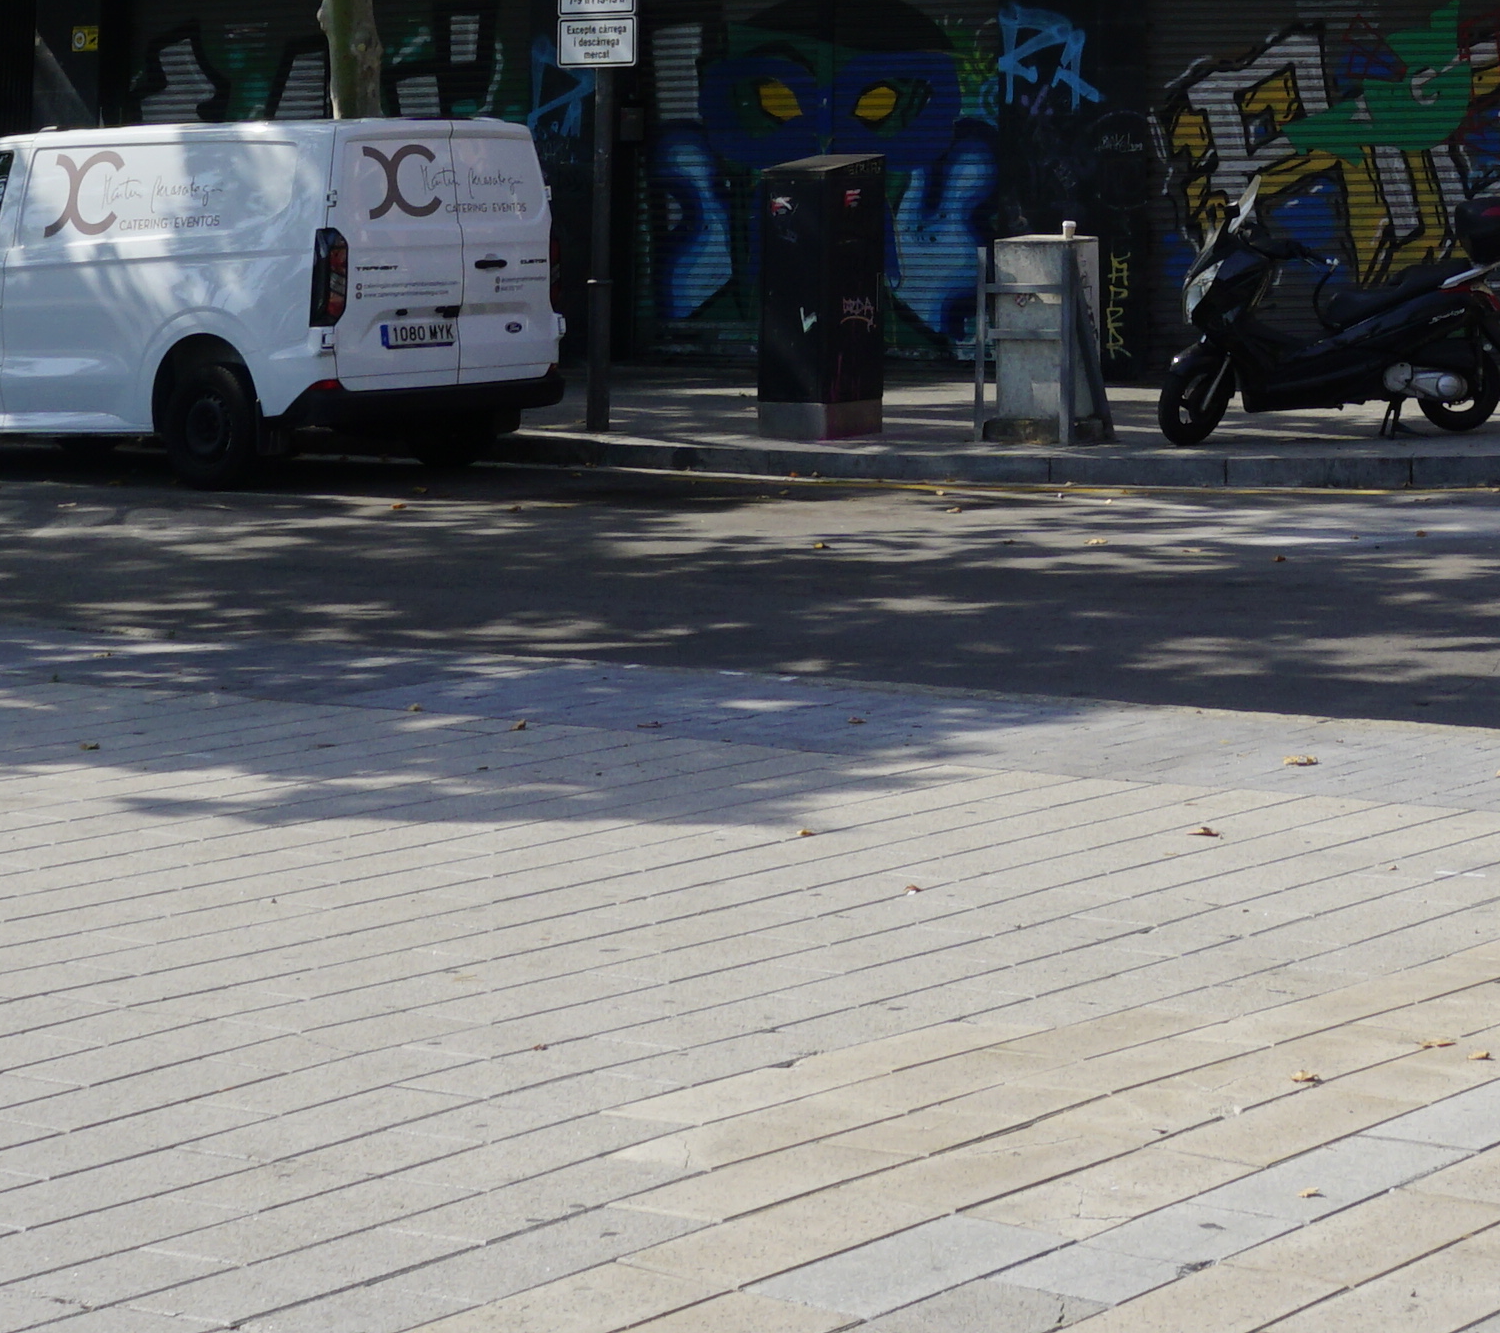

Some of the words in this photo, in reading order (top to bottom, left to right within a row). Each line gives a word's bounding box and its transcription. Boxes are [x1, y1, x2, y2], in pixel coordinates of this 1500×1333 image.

[566, 25, 597, 35] Excepte
[583, 50, 610, 60] mercat
[445, 203, 488, 213] CATERING
[491, 202, 527, 213] EVENTOS
[119, 217, 169, 231] CATERING
[173, 215, 221, 229] EVENTOS
[393, 326, 426, 342] 1080
[428, 324, 455, 341] MYK
